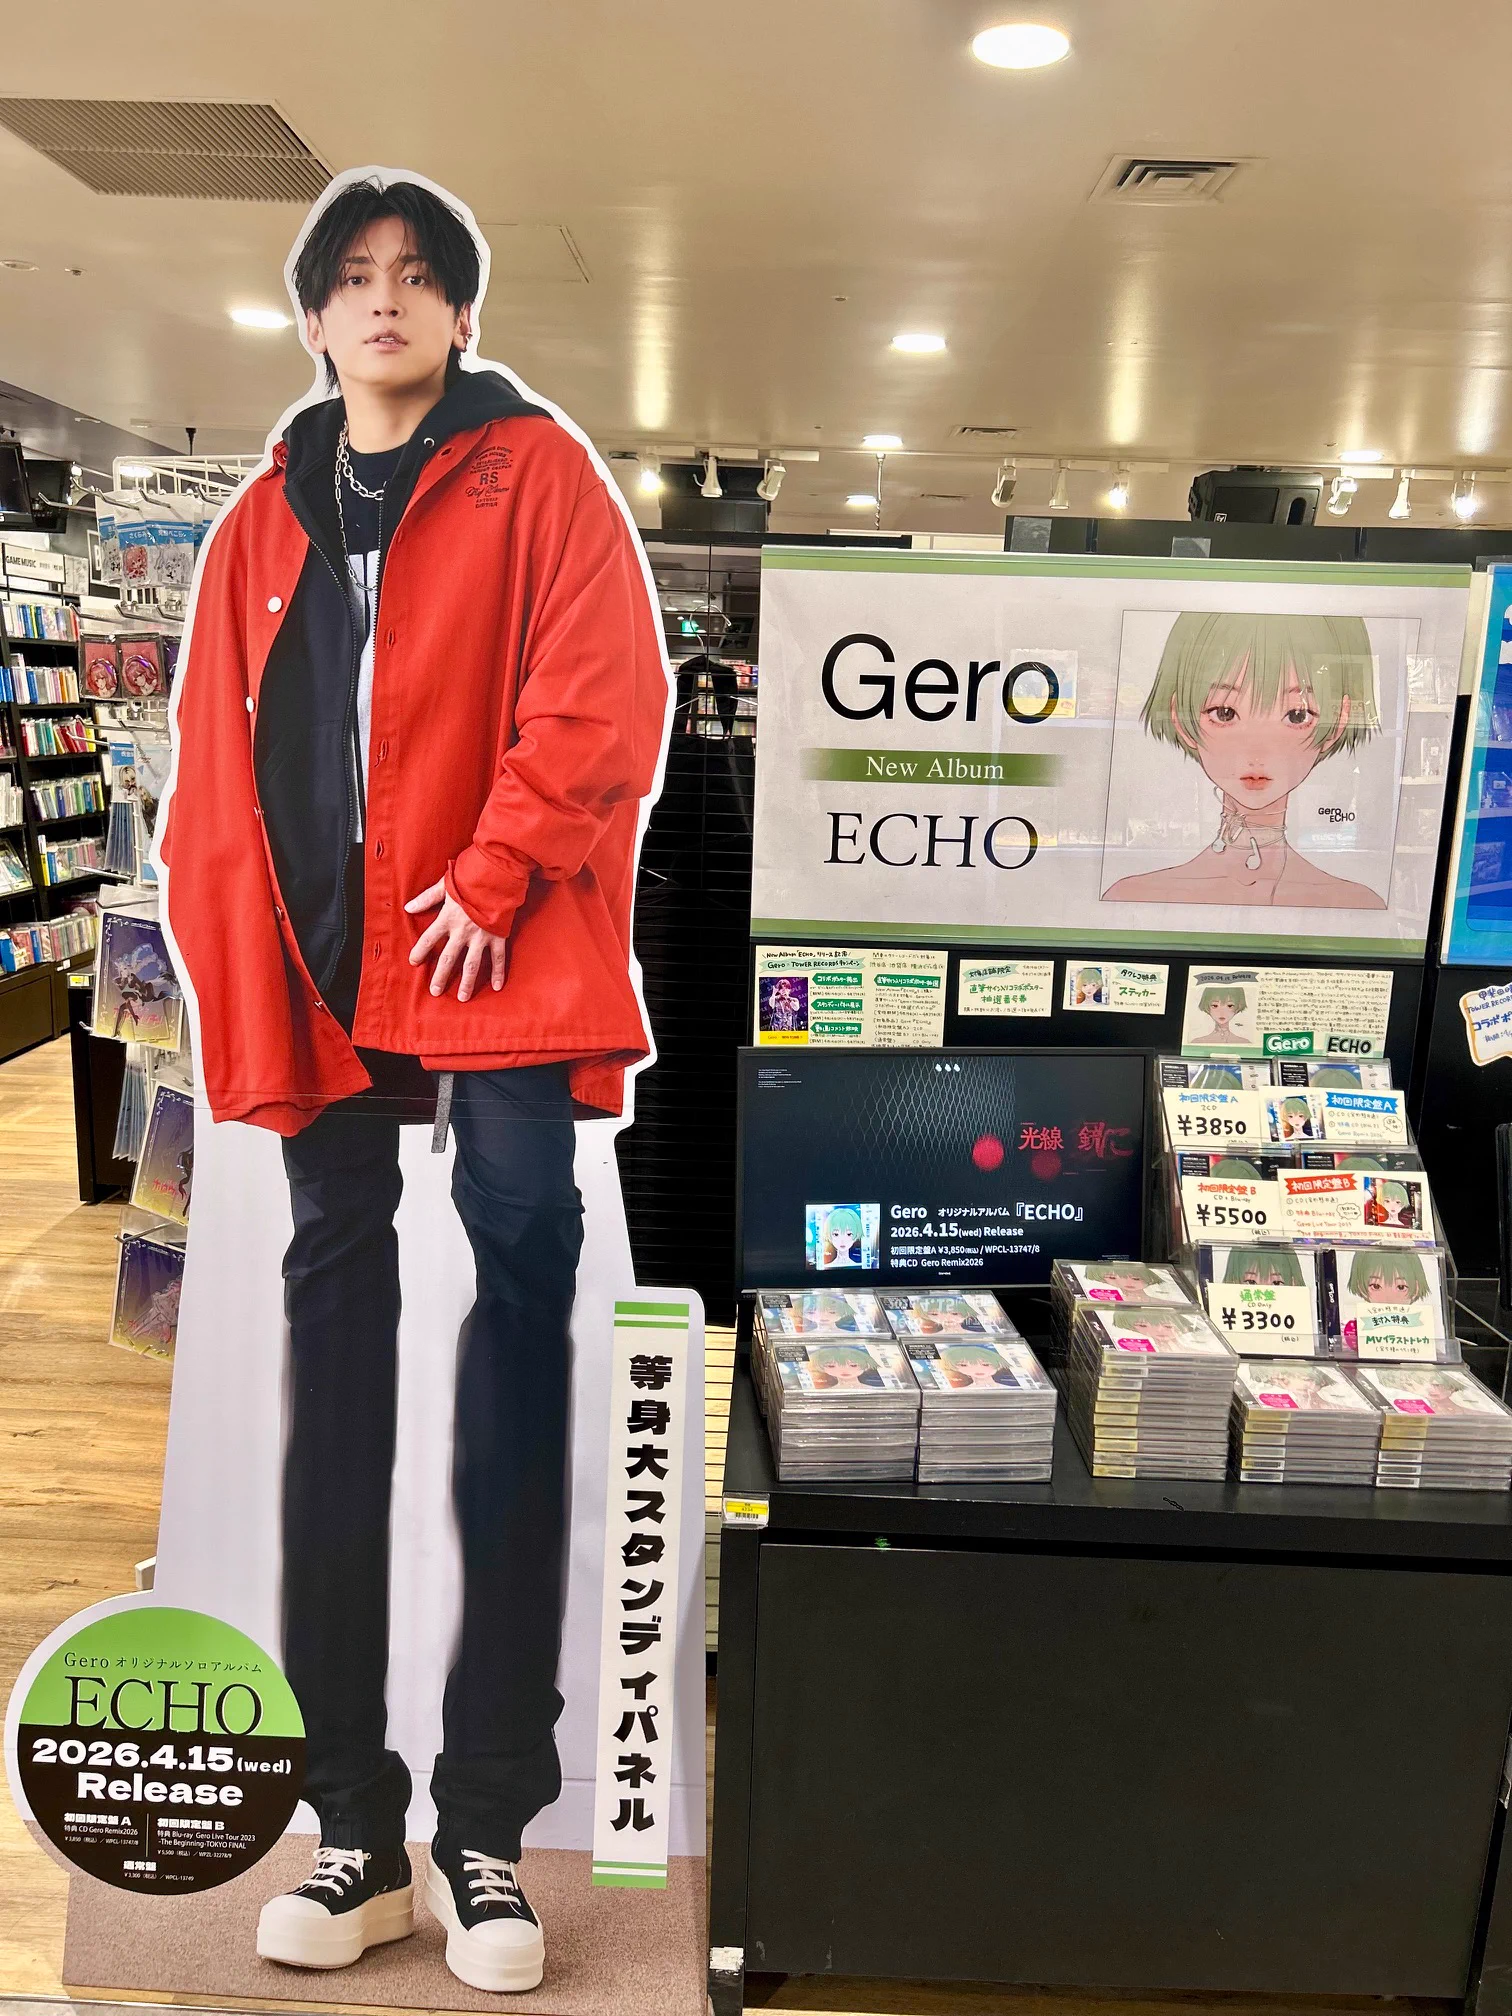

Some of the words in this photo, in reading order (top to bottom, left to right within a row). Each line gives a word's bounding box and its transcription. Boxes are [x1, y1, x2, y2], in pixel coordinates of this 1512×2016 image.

[5, 555, 21, 565] GAME
[21, 558, 37, 568] MUSIC
[821, 633, 1060, 725] Gero
[865, 755, 920, 777] New
[926, 756, 1005, 780] Album
[1318, 807, 1342, 816] Gero
[1329, 812, 1356, 823] ECHO
[823, 811, 1039, 870] ECHO
[767, 961, 786, 969] Gero
[968, 965, 1012, 978] 対象店舗限定
[1120, 968, 1158, 982] タワレコ特典
[969, 983, 1044, 994] 直筆サイン入りコラボポスター
[1119, 986, 1157, 997] ステッカー
[1267, 1035, 1311, 1052] Gero
[1327, 1037, 1372, 1054] ECHO
[1178, 1092, 1229, 1103] 初回限定盤
[1331, 1094, 1393, 1111] 初回限定盤A
[1177, 1114, 1247, 1136] ¥3850
[1017, 1125, 1065, 1151] 光線
[1197, 1182, 1248, 1195] 初回限定盤
[1249, 1186, 1257, 1195] B
[1291, 1177, 1351, 1192] 初回限定盤B
[890, 1204, 928, 1219] Gero
[937, 1207, 1010, 1217] オリジナルアルバム
[1015, 1201, 1085, 1222] 『ECHO』
[1196, 1203, 1267, 1226] ¥5500
[983, 1226, 1024, 1236] Release
[890, 1245, 936, 1255] 初回限定盤A
[985, 1244, 1040, 1254] WPCL-13747/8
[890, 1258, 918, 1268] 特典CD
[921, 1258, 940, 1267] Gero
[941, 1257, 984, 1267] Remix2026
[1240, 1288, 1277, 1301] 通常盤
[1221, 1306, 1295, 1330] ¥3300
[1371, 1314, 1410, 1327] 封入特典
[1365, 1334, 1430, 1345] MVイラストトレカ
[609, 1353, 674, 1834] 等身大スタンディパネル
[64, 1652, 110, 1669] Gero
[115, 1656, 262, 1673] オリジナルソロアルバム
[64, 1675, 264, 1736] ECHO
[77, 1771, 244, 1807] Release
[63, 1812, 119, 1826] 初回限定盤
[120, 1816, 132, 1826] A
[157, 1817, 213, 1831] 初回限定盤
[214, 1821, 225, 1831] B
[78, 1825, 88, 1834] CD
[89, 1826, 104, 1835] Gero
[104, 1827, 139, 1836] Remix2026
[172, 1830, 194, 1839] Blu-ray
[196, 1831, 211, 1840] Gero
[211, 1832, 224, 1840] Live
[224, 1832, 240, 1841] Tour
[240, 1833, 256, 1842] 2023
[228, 1840, 247, 1849] FINAL
[123, 1860, 157, 1872] 通常盤
